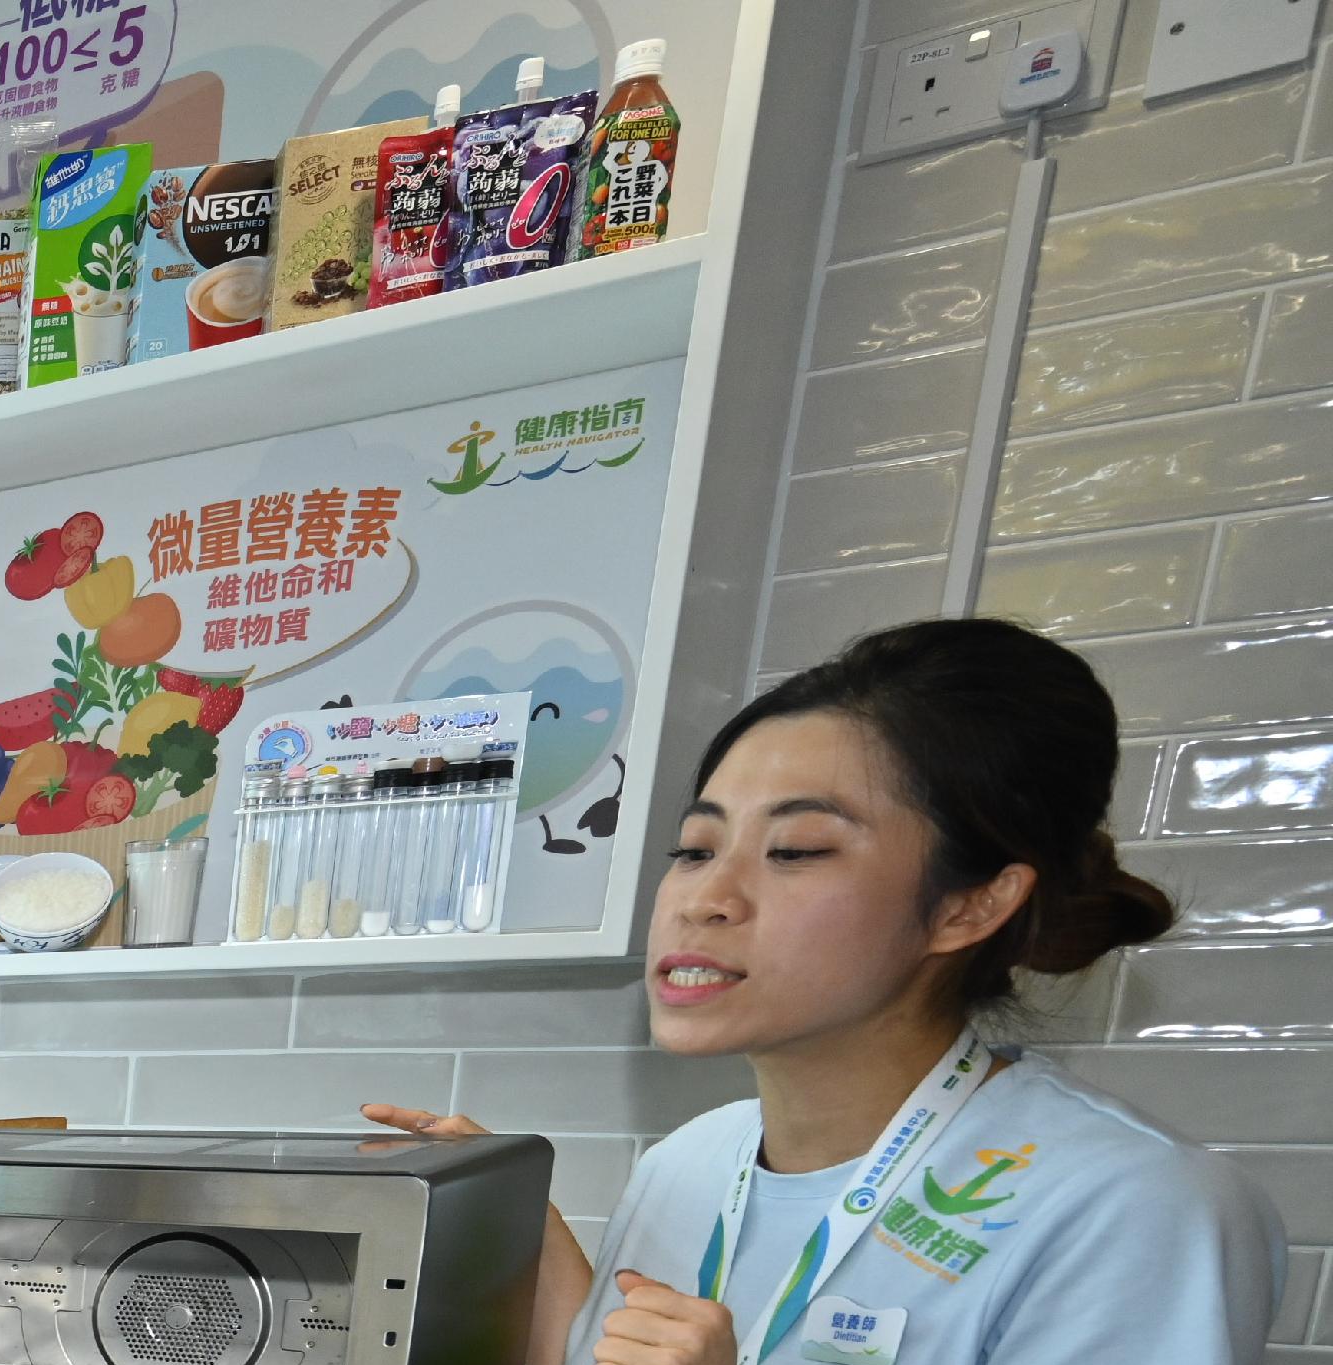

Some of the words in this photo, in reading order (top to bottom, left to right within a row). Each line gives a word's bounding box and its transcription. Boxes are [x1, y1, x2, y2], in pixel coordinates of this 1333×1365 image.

[610, 131, 631, 141] FOR
[631, 128, 652, 139] ONE
[652, 126, 672, 138] DAY
[617, 119, 670, 131] VEGETABLES
[466, 131, 501, 143] ORIHIRO
[288, 165, 341, 197] SELECT
[190, 218, 266, 235] UNSWEETENED
[149, 340, 163, 351] 20
[514, 441, 565, 457] HEALTH
[566, 426, 641, 448] NAVIGATOR
[146, 486, 402, 583] 微量營養素
[206, 559, 355, 610] 維他命和
[202, 606, 312, 653] 礦物質
[831, 1311, 878, 1333] 營養師
[833, 1330, 867, 1343] Dietitian
